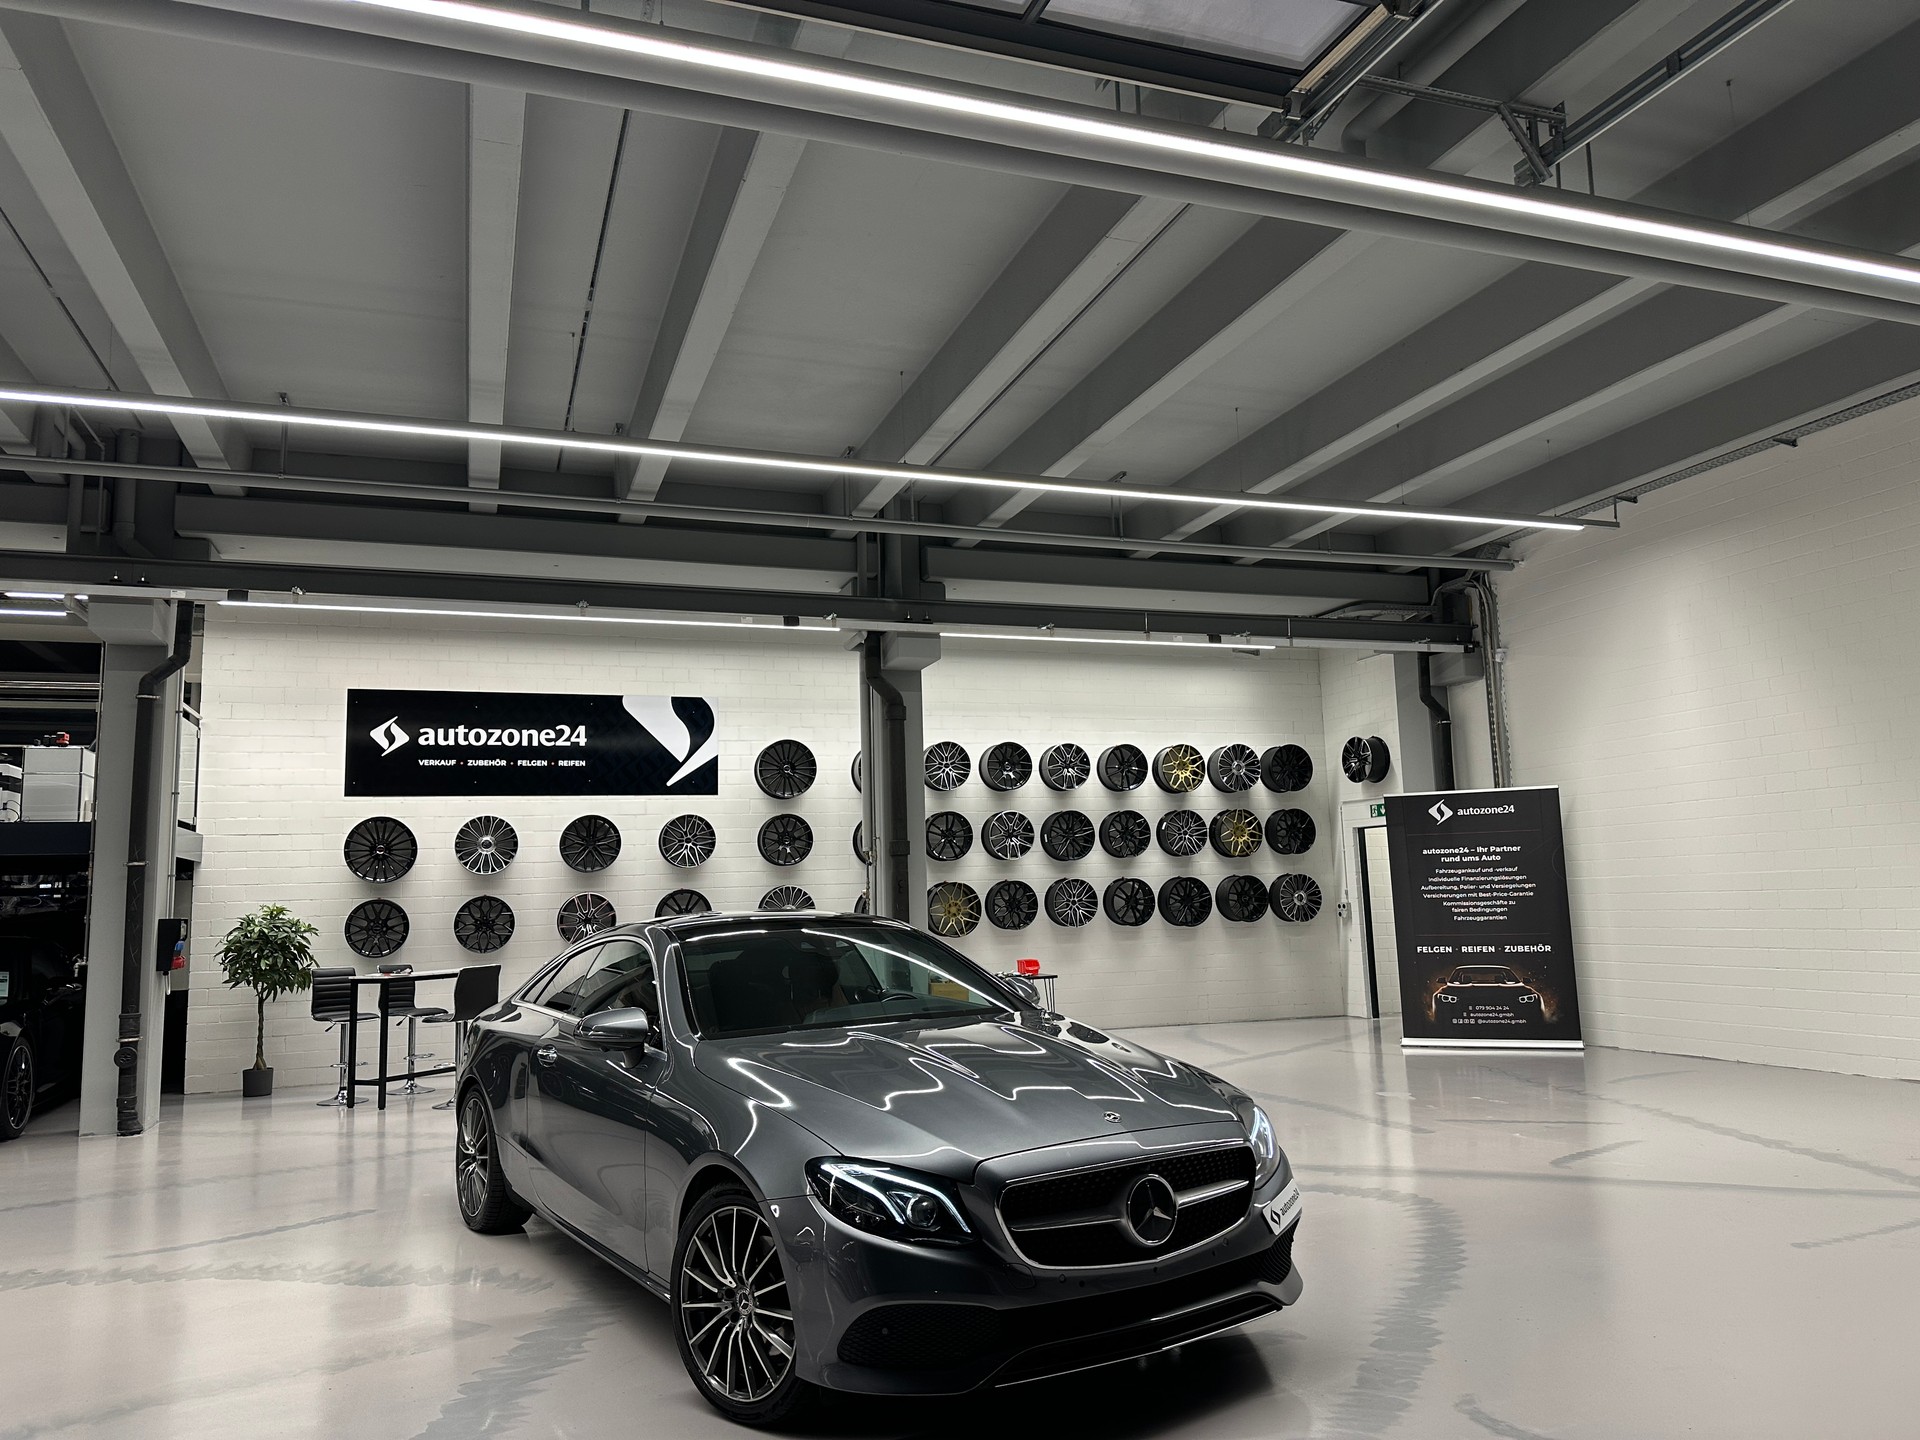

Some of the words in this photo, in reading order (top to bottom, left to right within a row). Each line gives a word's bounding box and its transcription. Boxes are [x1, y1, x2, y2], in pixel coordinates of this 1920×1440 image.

[417, 724, 588, 747] autozone24
[467, 758, 507, 767] ZUBEHÖR
[1457, 804, 1515, 816] autozone24
[1422, 846, 1469, 855] autozone24
[1490, 845, 1521, 853] Partner
[1435, 867, 1481, 875] Fahrzeugankauf
[1461, 874, 1527, 882] Finanzierungslösungen
[1461, 945, 1496, 953] REIFEN
[1504, 943, 1552, 953] ZUBEHÖR
